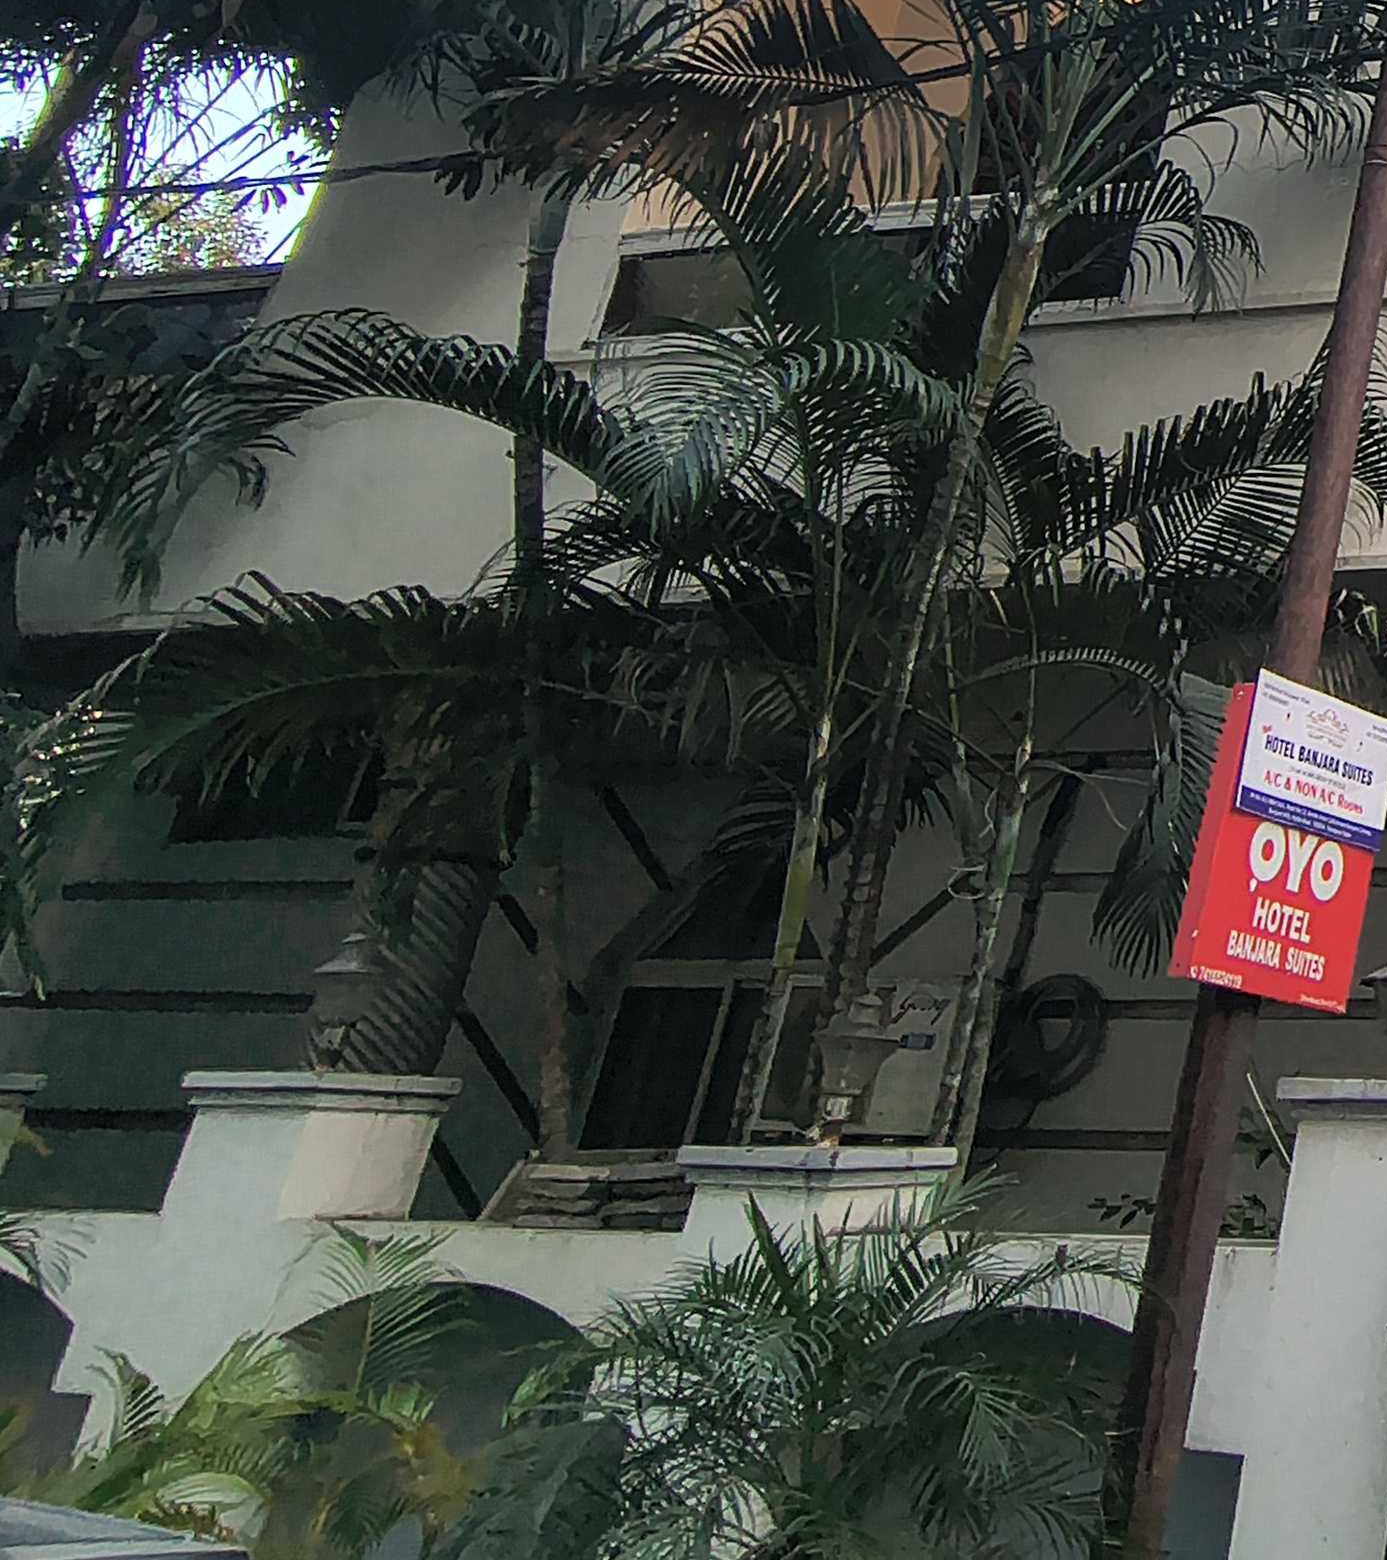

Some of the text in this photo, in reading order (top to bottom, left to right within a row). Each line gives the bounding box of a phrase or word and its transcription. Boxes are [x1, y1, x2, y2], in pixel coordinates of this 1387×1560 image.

[1265, 735, 1296, 760] HOTEL
[1299, 746, 1340, 774] BANJARA
[1341, 761, 1374, 787] SUITES
[1295, 780, 1317, 798] NON
[1249, 821, 1345, 902] OYO
[1252, 897, 1312, 944] HOTEL
[1227, 930, 1326, 980] BANJARA SUITES
